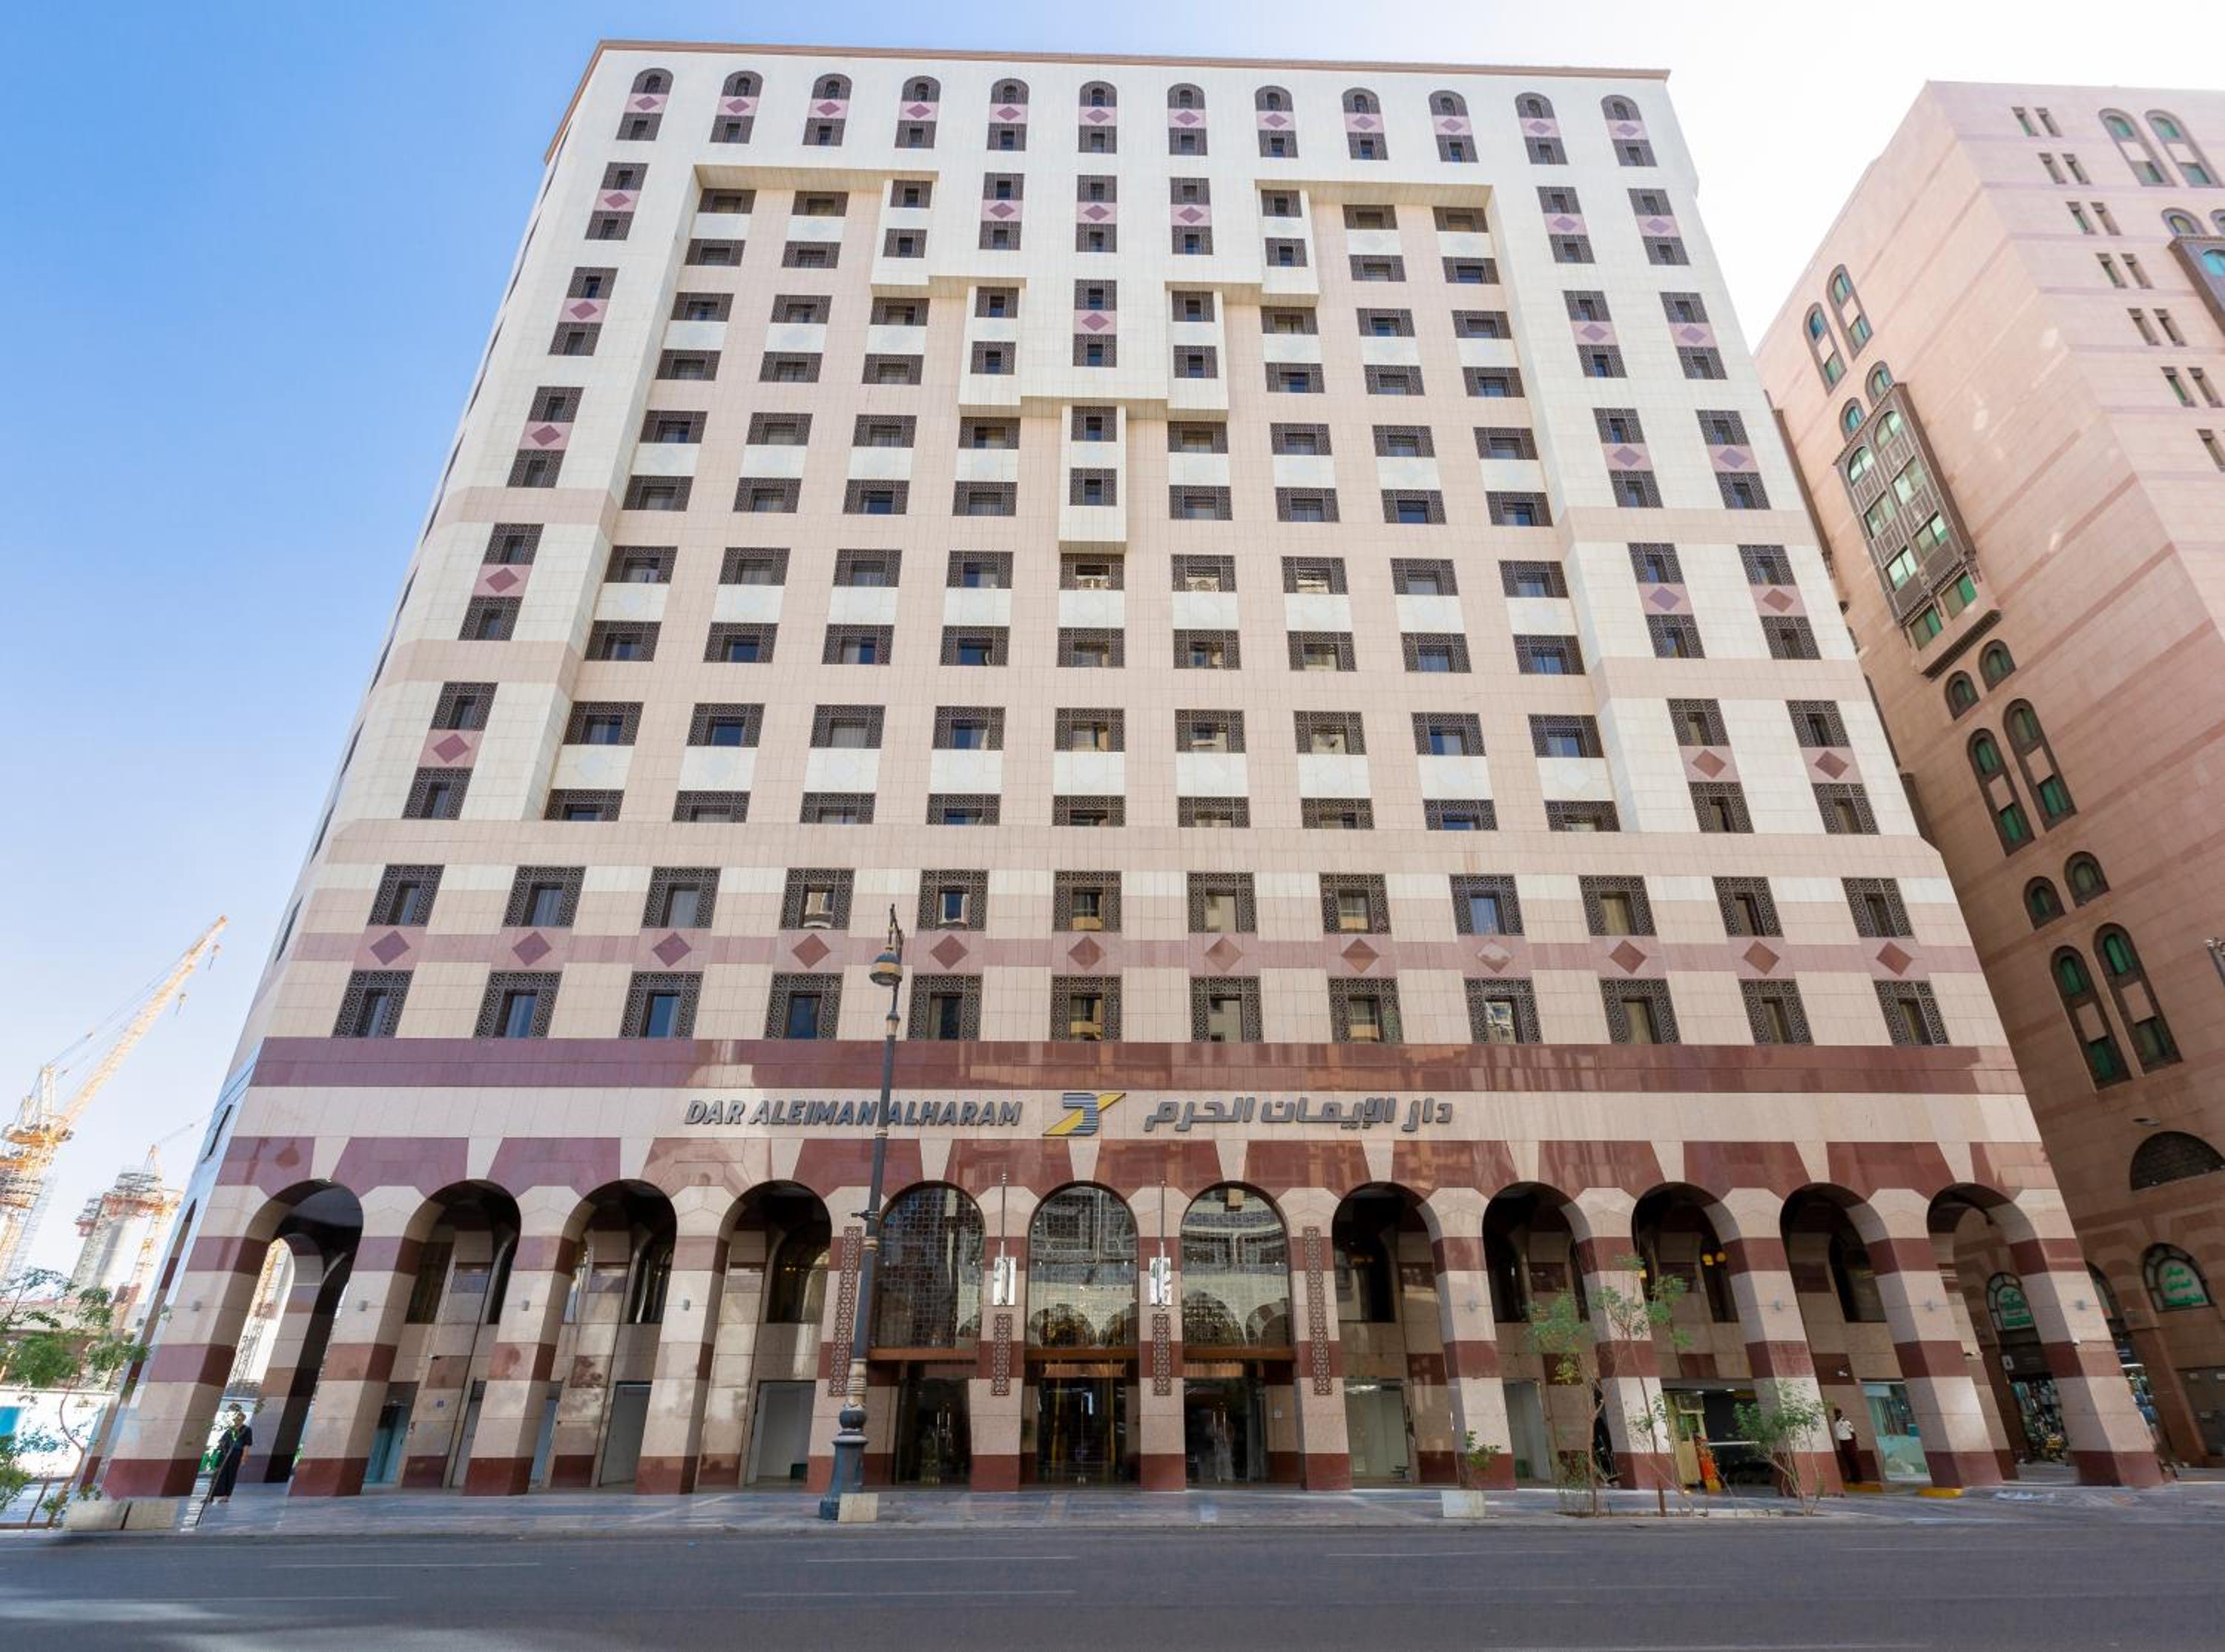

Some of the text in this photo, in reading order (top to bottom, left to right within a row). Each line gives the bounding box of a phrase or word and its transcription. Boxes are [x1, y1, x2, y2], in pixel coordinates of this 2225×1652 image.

[685, 1100, 1023, 1126] DAR ALEIMAN ALHARAM
[1144, 1097, 1453, 1131] دار الإيمان الحرم
